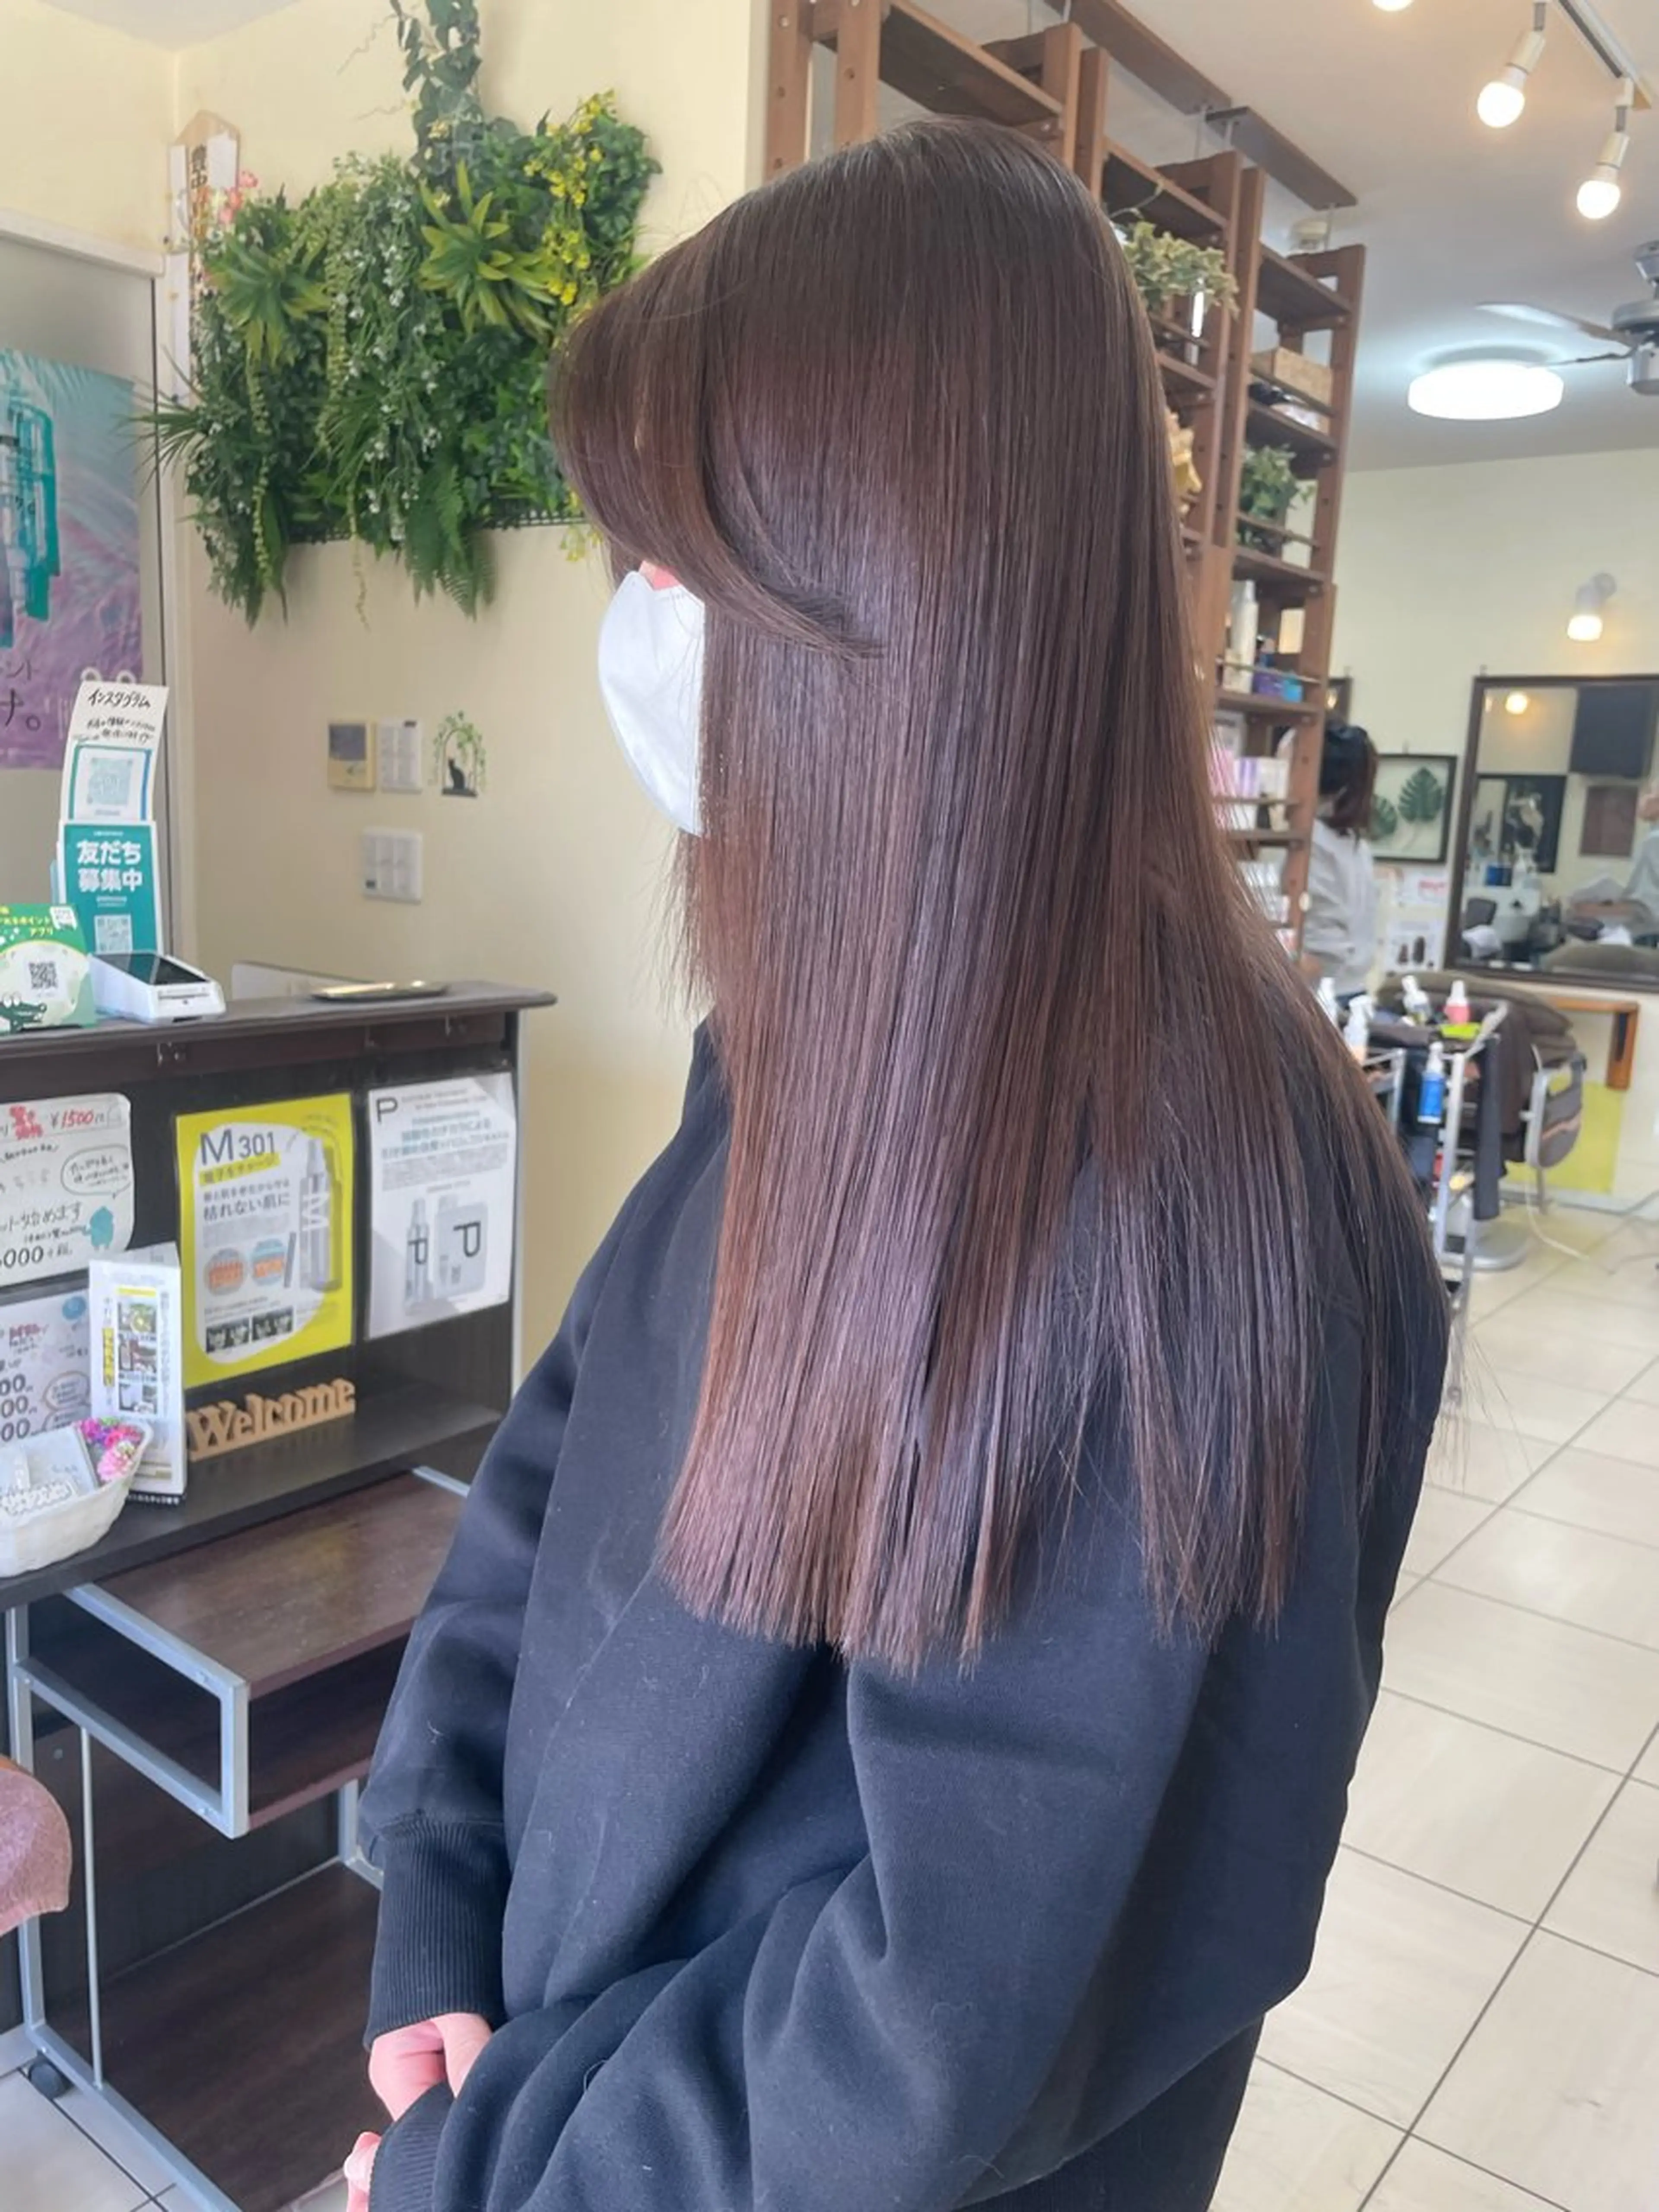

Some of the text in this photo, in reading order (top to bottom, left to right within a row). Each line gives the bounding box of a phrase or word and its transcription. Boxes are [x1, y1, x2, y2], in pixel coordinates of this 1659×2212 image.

[87, 688, 151, 708] インスタグラム
[76, 840, 142, 864] 友だち
[78, 868, 143, 892] 募集中
[376, 1097, 398, 1123] P
[203, 1193, 291, 1222] 枯れない肌に
[187, 1378, 356, 1463] Welcome
